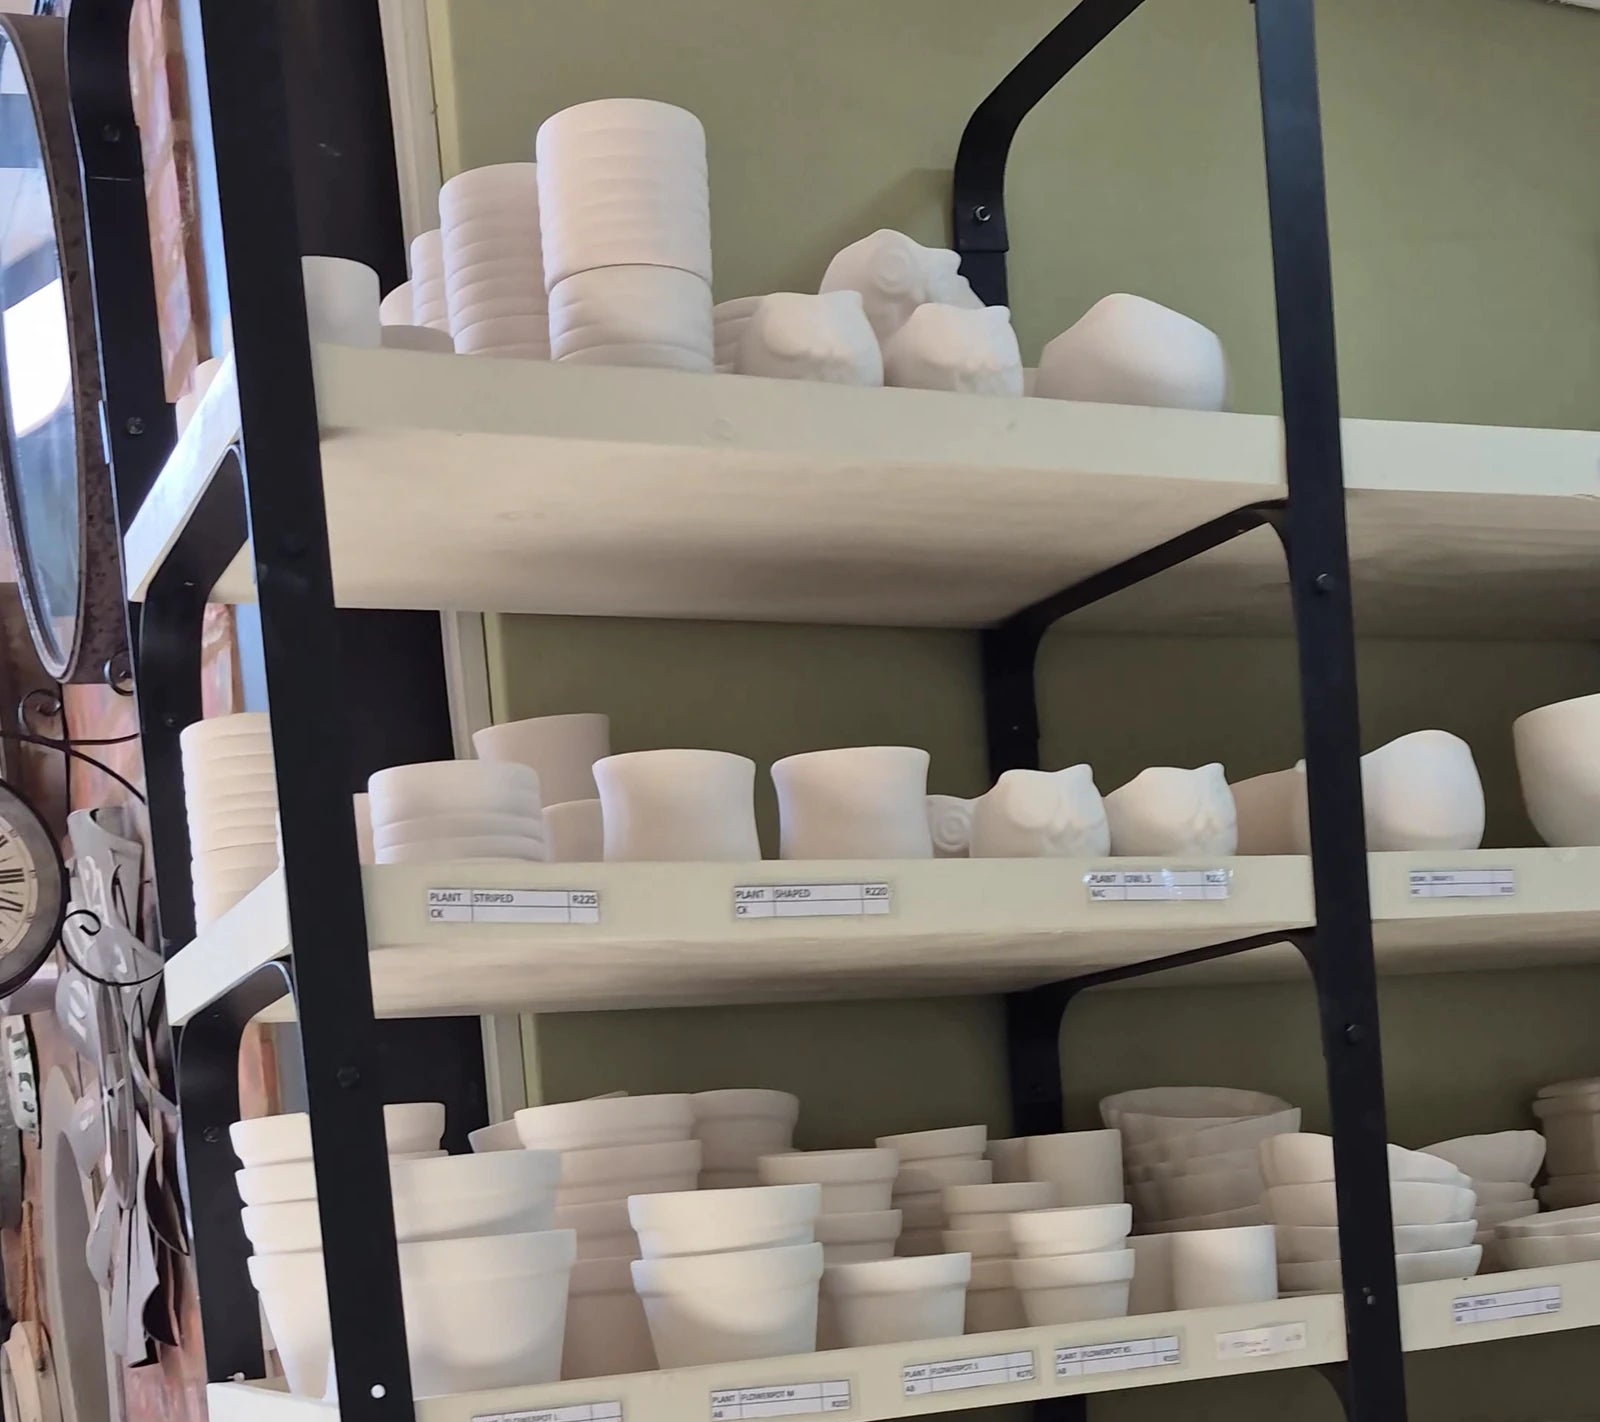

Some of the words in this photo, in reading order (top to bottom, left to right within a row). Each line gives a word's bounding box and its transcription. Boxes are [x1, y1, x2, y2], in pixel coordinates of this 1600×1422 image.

[430, 893, 461, 902] PLANT
[473, 893, 514, 903] STRIPED
[572, 894, 597, 904] R225
[736, 889, 764, 899] PLANT
[775, 889, 811, 899] SHAPED
[430, 909, 443, 918] CK
[1056, 1352, 1077, 1361] PLANT
[904, 1369, 926, 1378] PLANT
[712, 1395, 735, 1403] PLANT
[741, 1389, 785, 1401] FLOWERPOT
